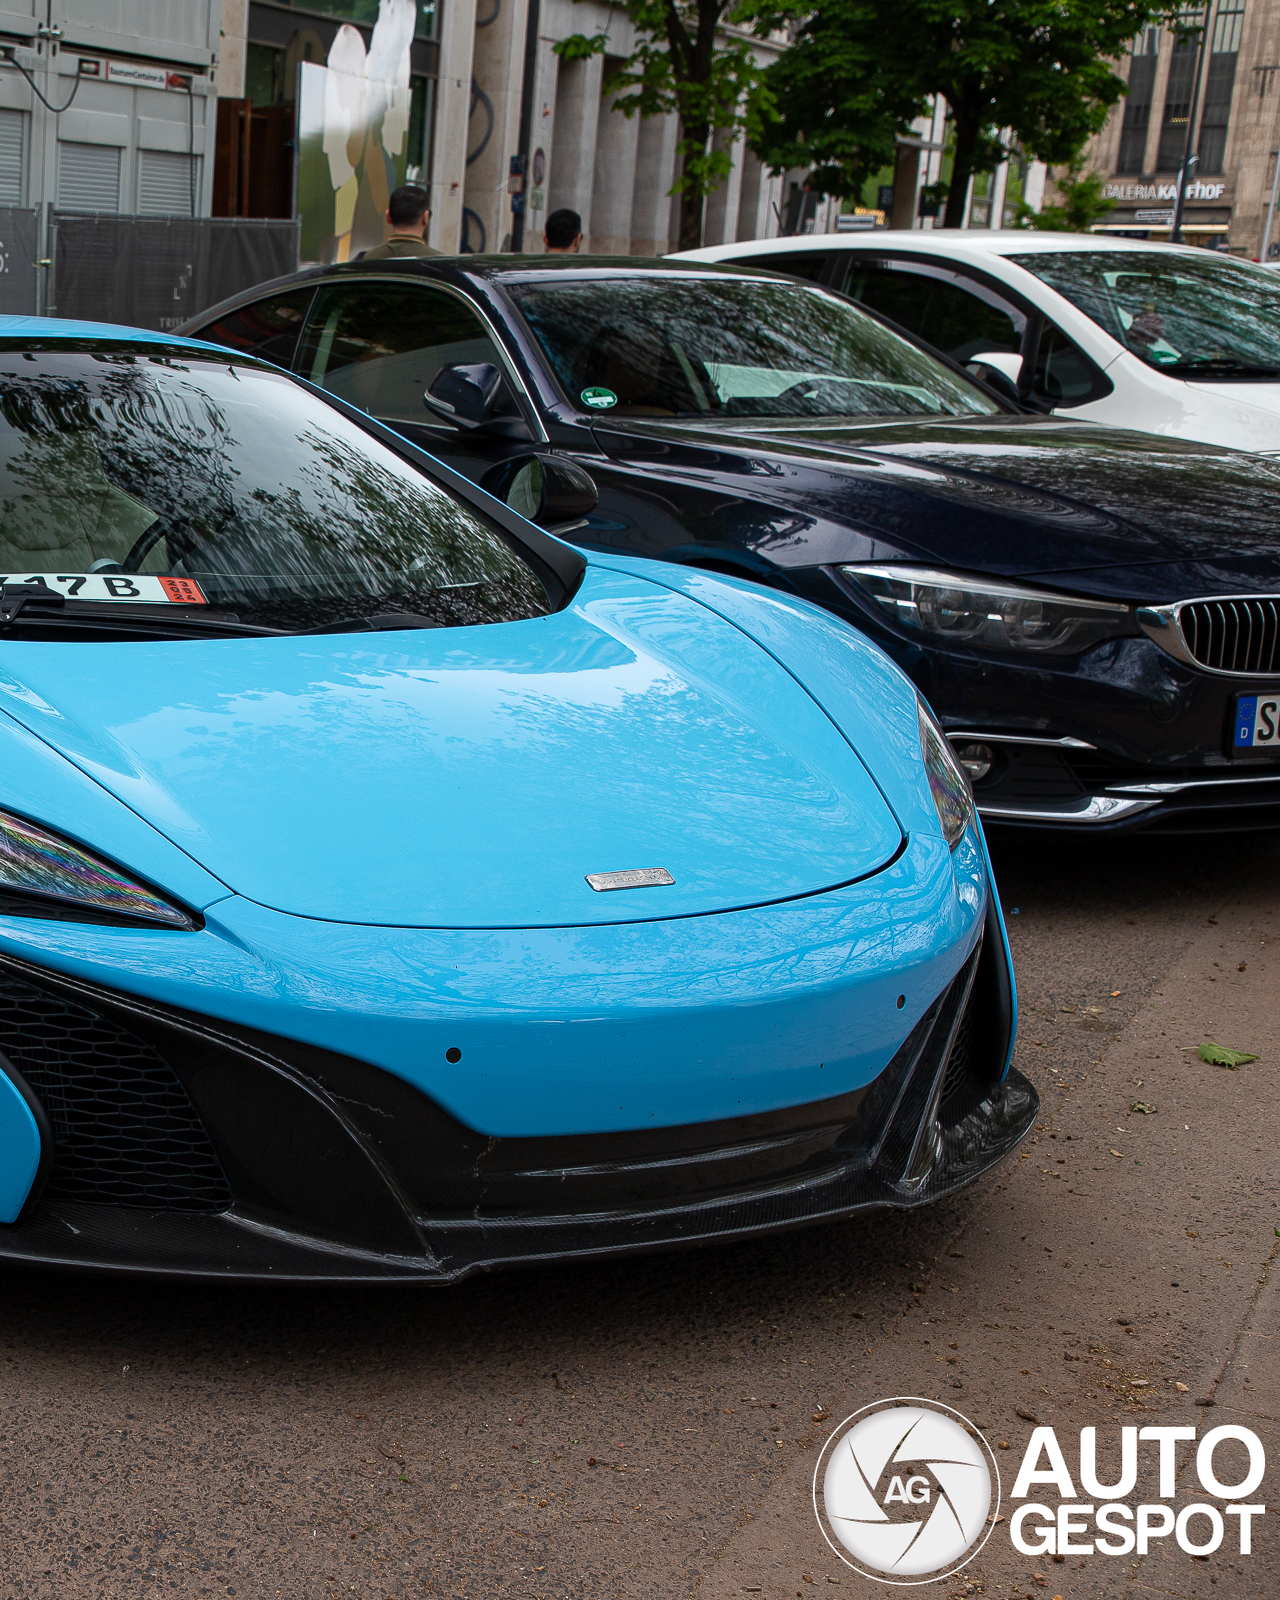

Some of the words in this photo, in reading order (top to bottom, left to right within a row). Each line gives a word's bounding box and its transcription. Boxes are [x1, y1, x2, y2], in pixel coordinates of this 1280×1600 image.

[1100, 183, 1157, 200] GALERIA
[102, 576, 141, 597] B
[1240, 727, 1249, 739] D
